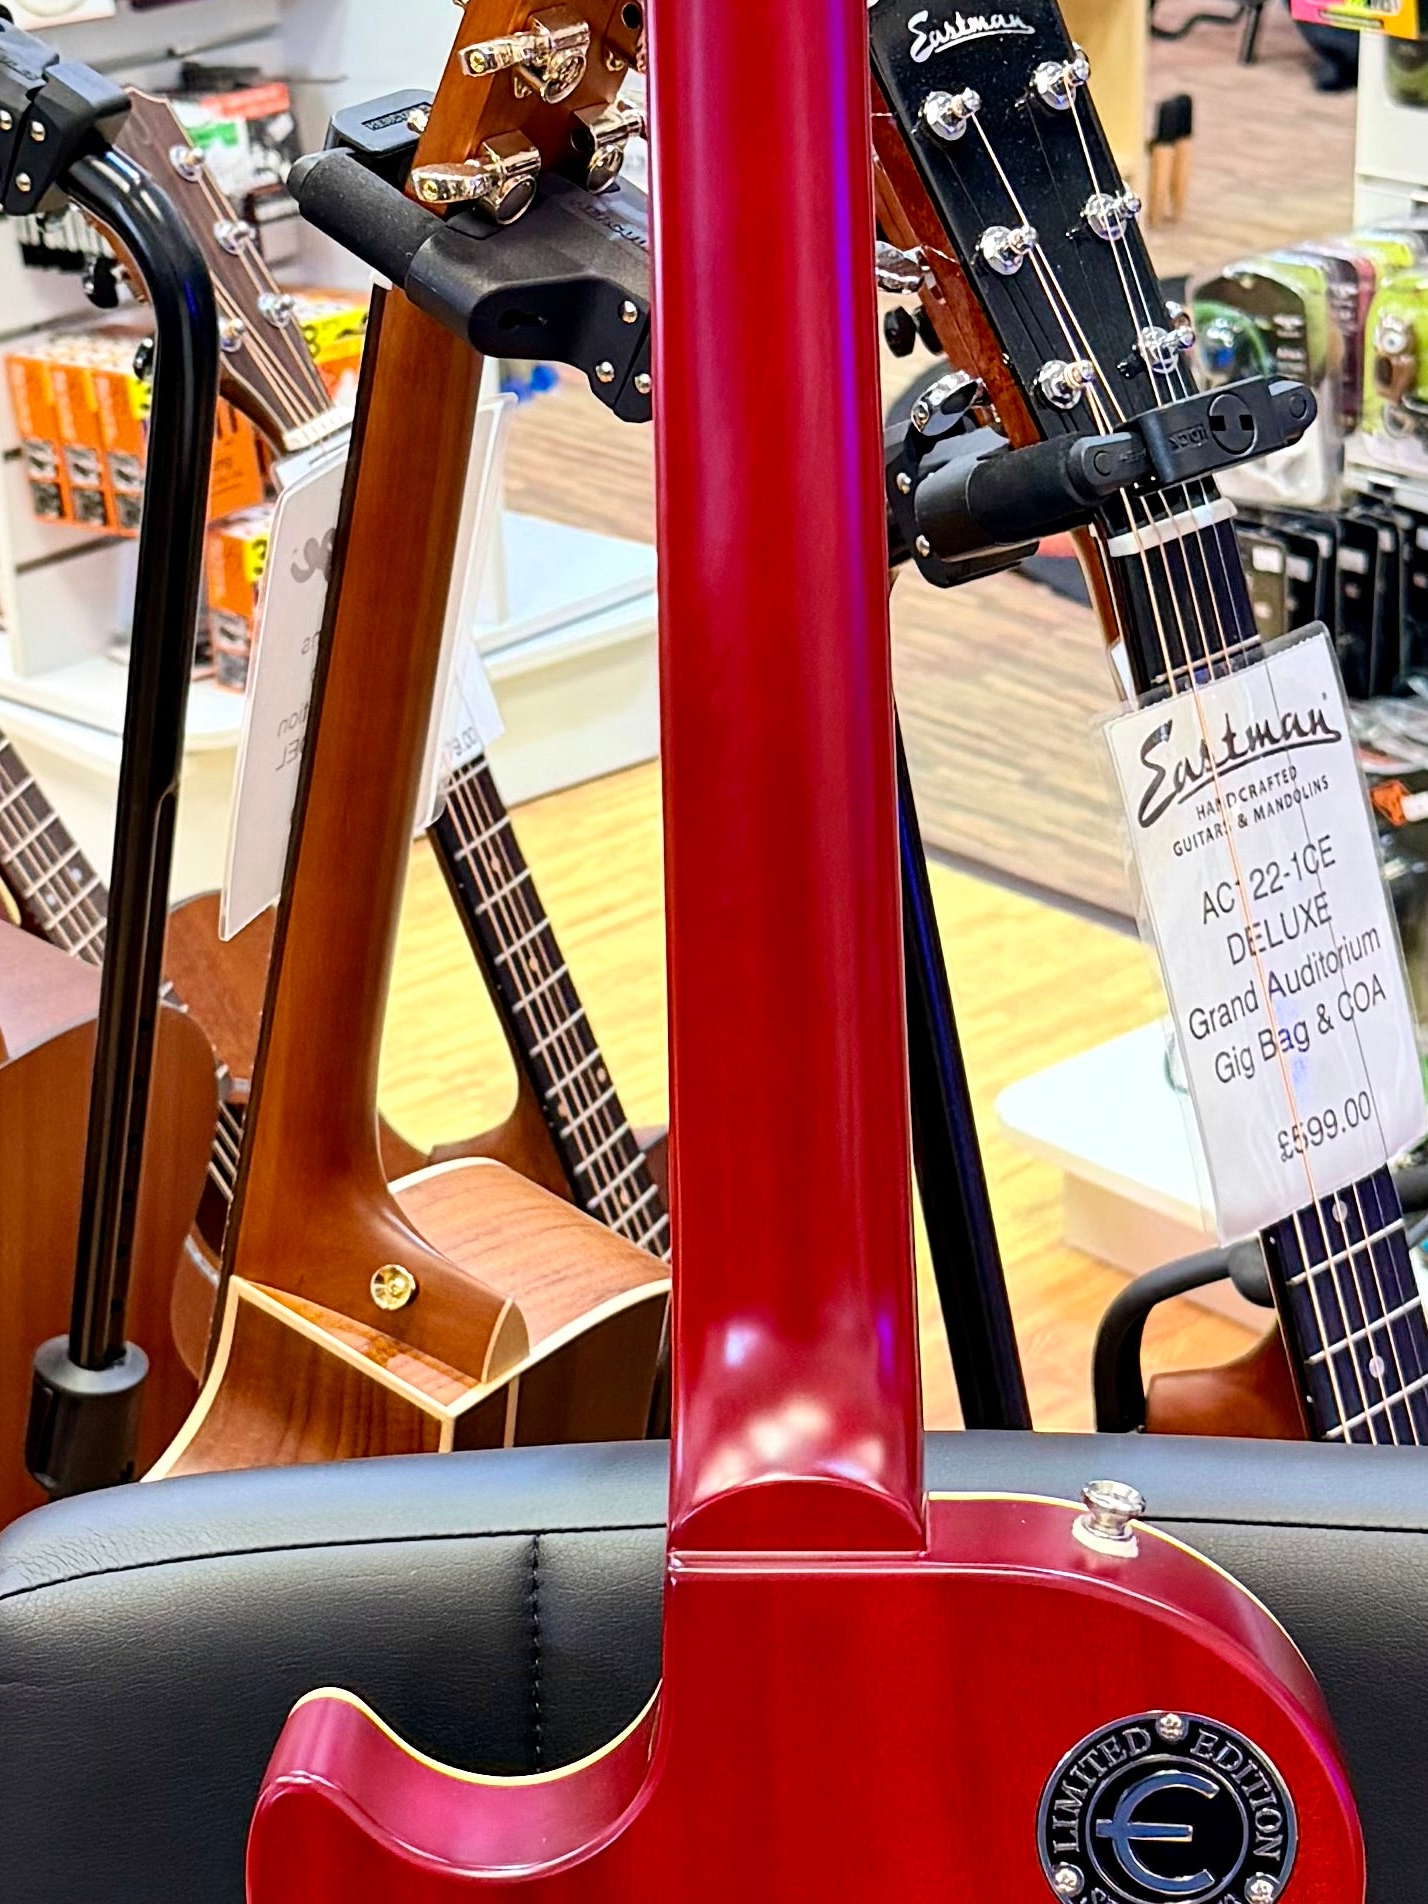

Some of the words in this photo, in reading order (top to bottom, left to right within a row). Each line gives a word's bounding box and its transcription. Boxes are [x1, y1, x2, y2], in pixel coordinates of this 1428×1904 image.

[907, 9, 1035, 63] Eastman
[1138, 708, 1342, 828] Eastman
[1196, 765, 1298, 821] HANDCRAFTED
[1172, 820, 1232, 857] GUITARS
[1237, 813, 1249, 828] &
[1254, 775, 1329, 823] MANDOLINS
[1202, 835, 1336, 924] AC22-1CE
[1226, 892, 1332, 966] DELUXE
[1189, 980, 1259, 1040] Grand
[1267, 927, 1381, 999] Auditorium
[1215, 1046, 1255, 1084] Gig
[1258, 1019, 1310, 1062] Bag
[1316, 1003, 1334, 1034] &
[1337, 974, 1387, 1022] COA
[1277, 1090, 1372, 1163] £599.00
[1053, 1727, 1152, 1854] LIMITED
[1190, 1728, 1283, 1861] EDITION
